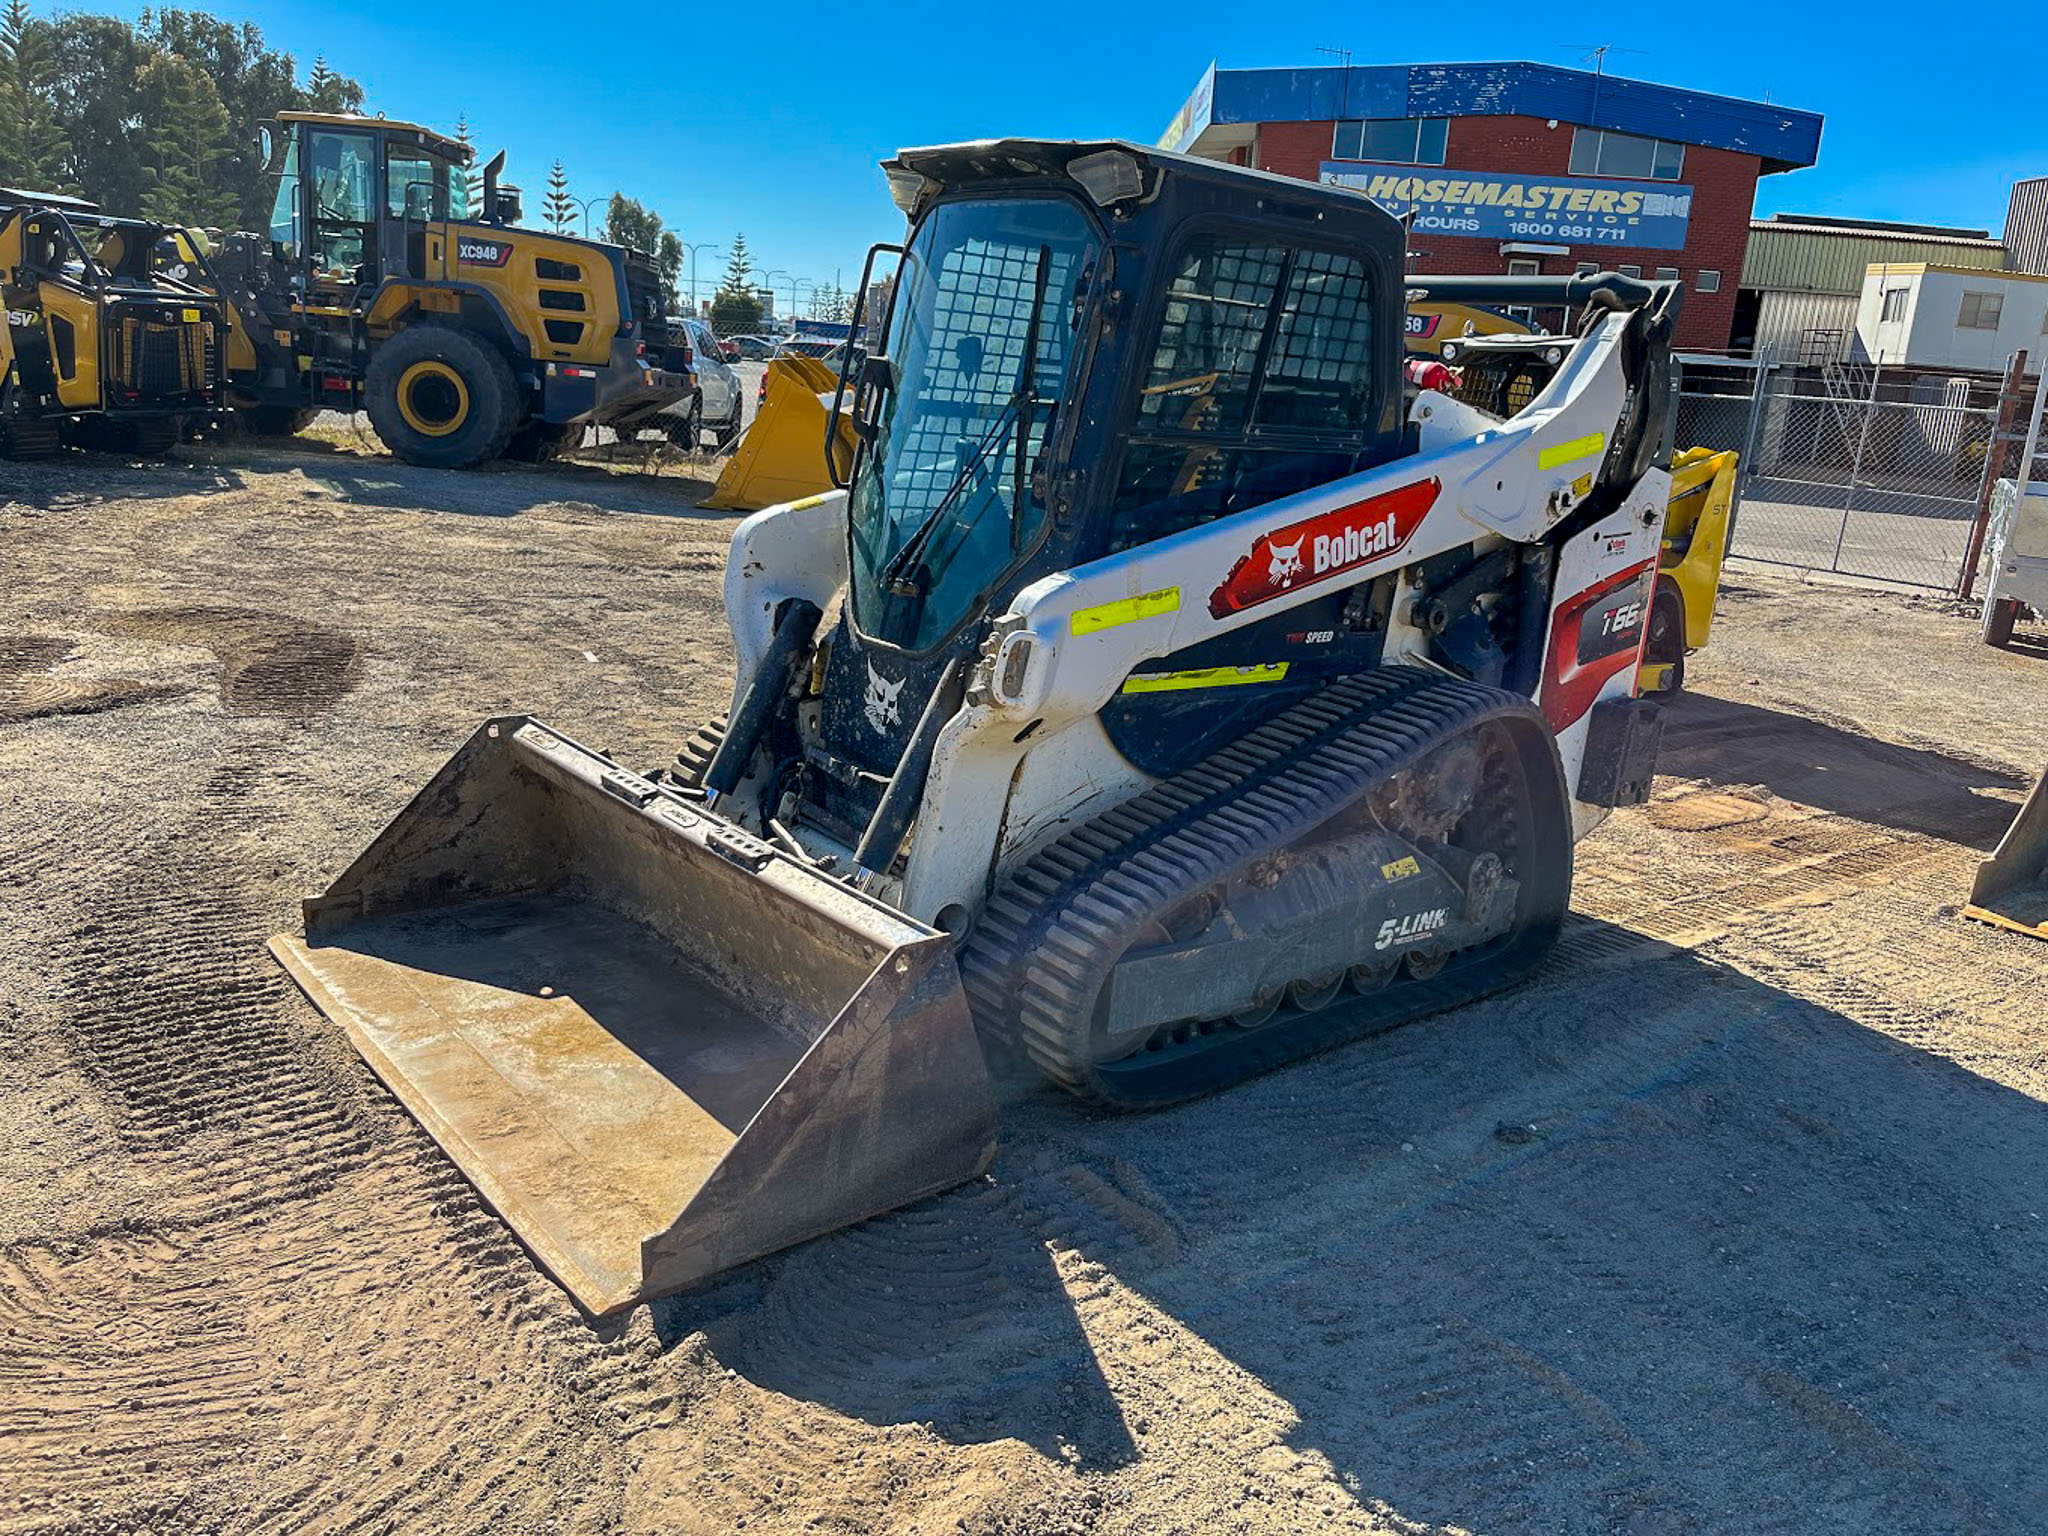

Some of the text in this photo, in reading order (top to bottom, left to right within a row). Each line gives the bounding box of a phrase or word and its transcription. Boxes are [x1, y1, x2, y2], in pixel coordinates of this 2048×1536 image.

[1367, 175, 1644, 215] HOSEMASTERS
[1412, 216, 1627, 240] HOURS 1800 681 711
[1503, 210, 1640, 225] SERVICE
[460, 244, 498, 261] XC948
[1313, 511, 1397, 575] Bobcat
[1305, 630, 1334, 644] SPEED
[1374, 908, 1446, 950] 5-LINK
